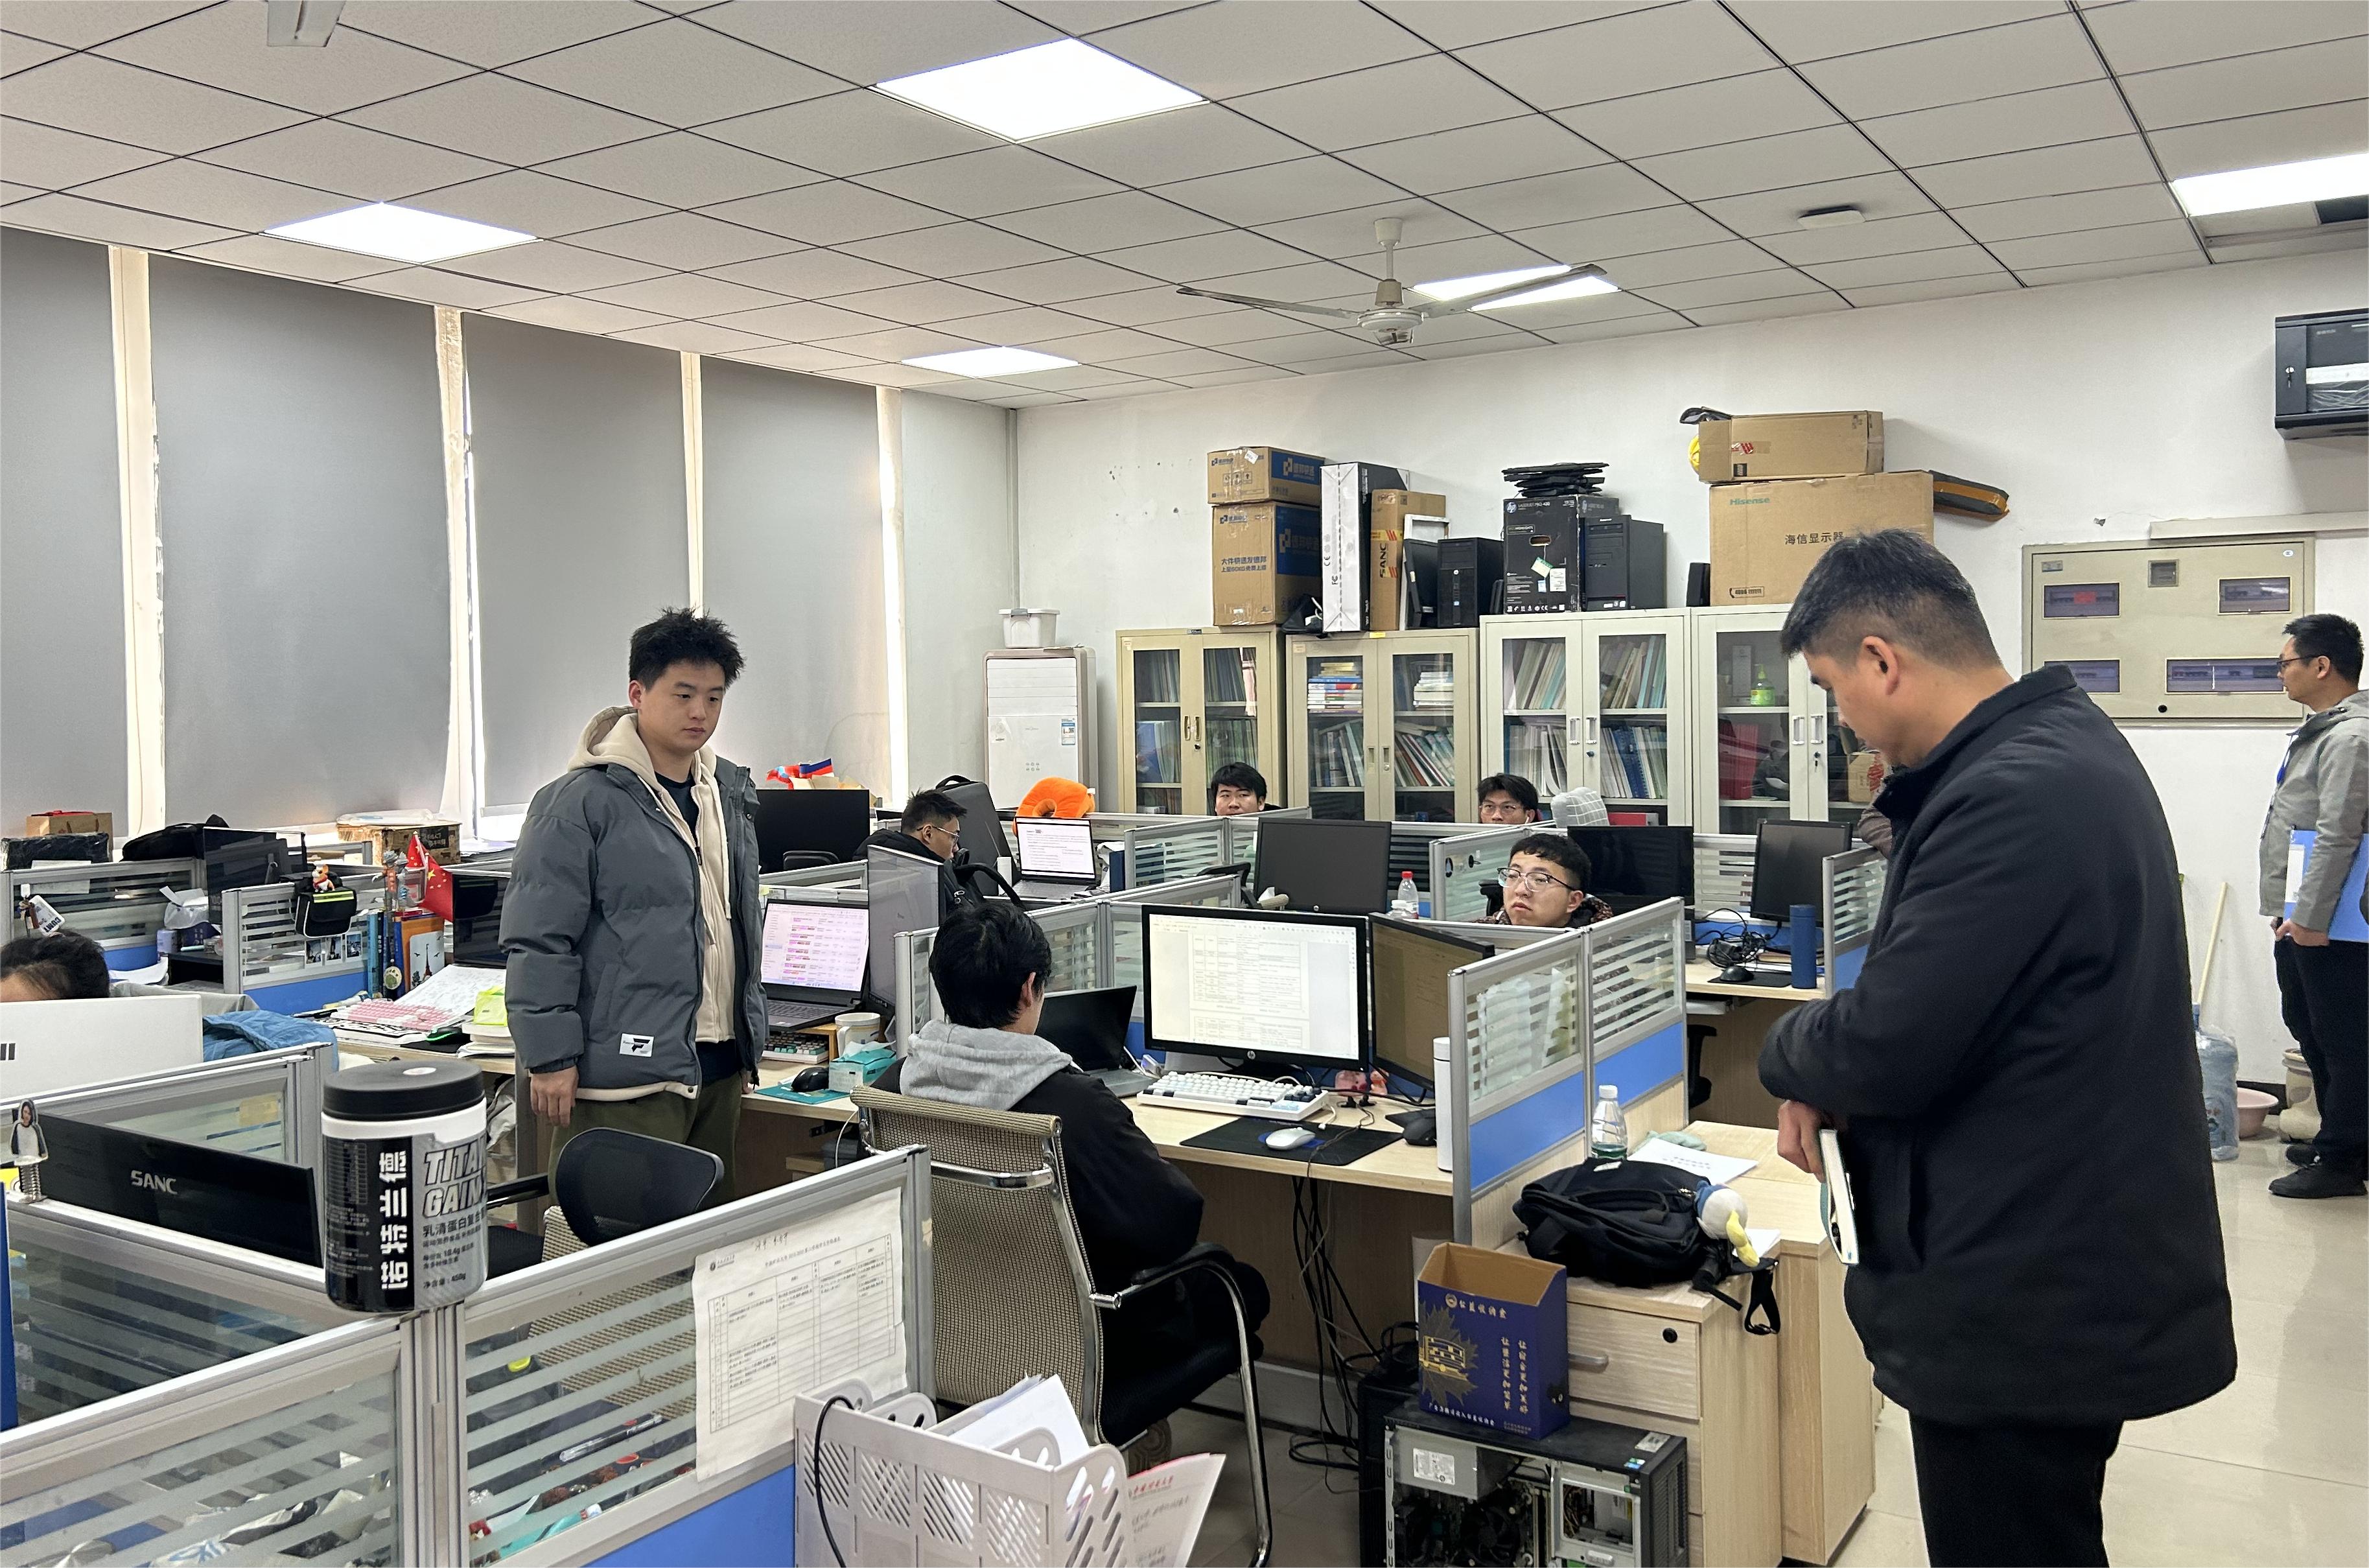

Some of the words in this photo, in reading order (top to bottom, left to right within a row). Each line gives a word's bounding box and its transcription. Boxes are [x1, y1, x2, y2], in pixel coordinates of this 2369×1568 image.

[1730, 497, 1771, 506] Hisense
[1784, 532, 1845, 545] 海信显示器
[1379, 543, 1389, 578] SANC
[131, 1170, 178, 1195] SANC
[379, 1151, 408, 1290] 诺特兰德
